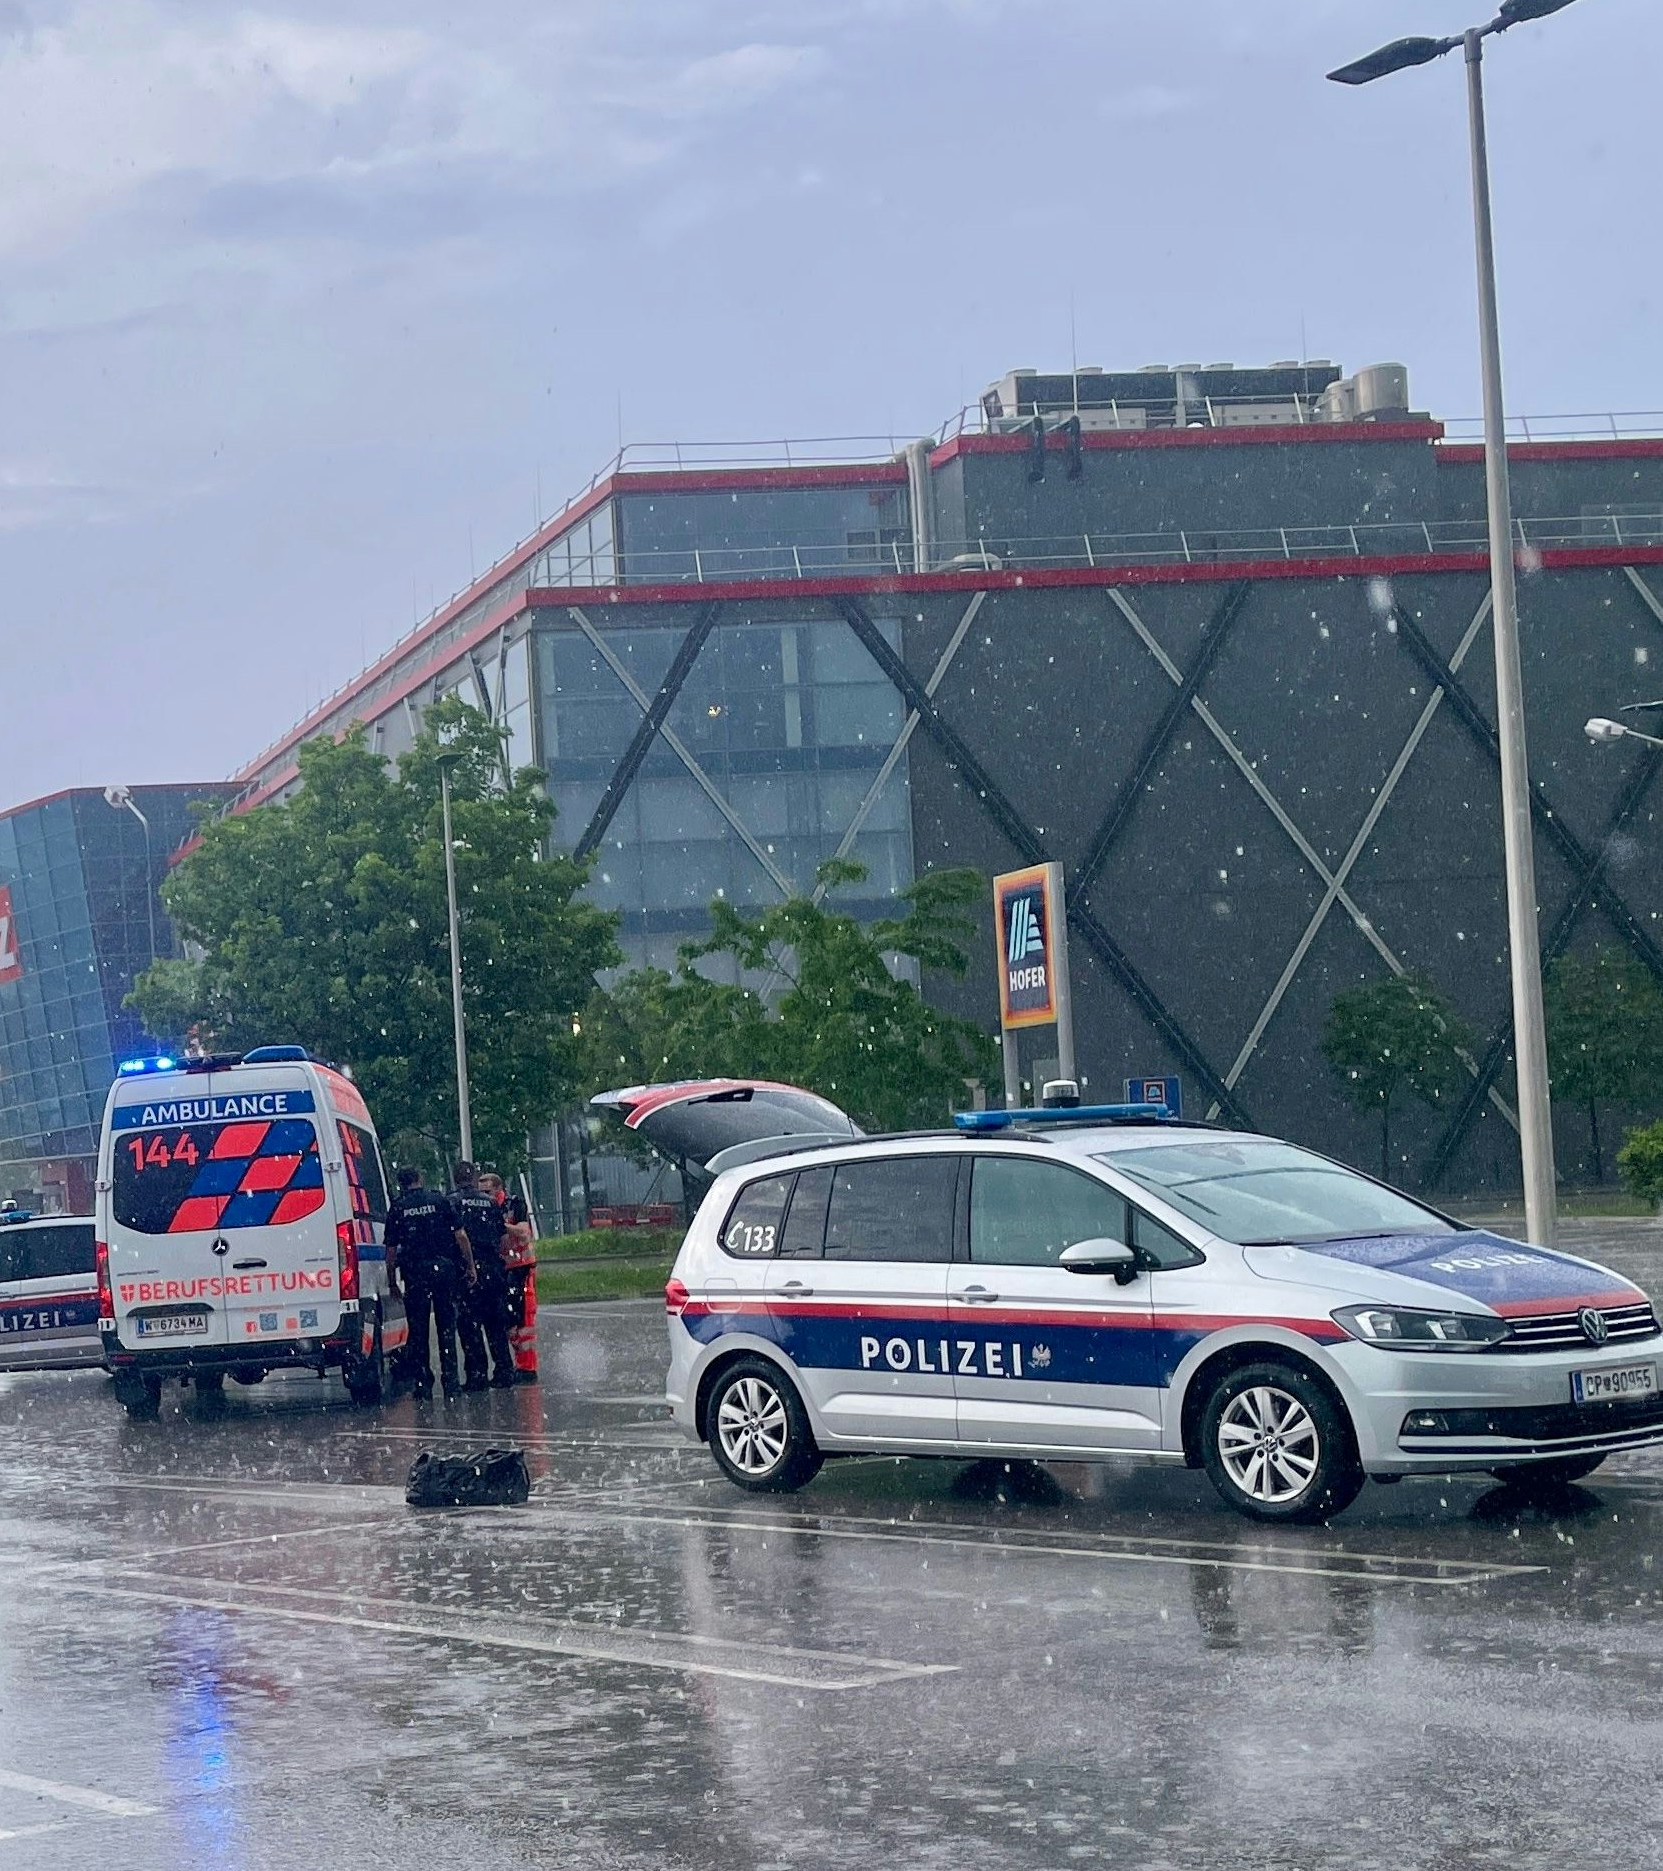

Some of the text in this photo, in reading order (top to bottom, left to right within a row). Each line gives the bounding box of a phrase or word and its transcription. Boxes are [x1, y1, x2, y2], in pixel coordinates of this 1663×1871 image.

[1009, 965, 1046, 992] HOFER
[141, 1094, 287, 1125] AMBULANCE
[128, 1132, 200, 1171] 144
[744, 1225, 776, 1252] 133
[1429, 1253, 1554, 1273] POLIZE
[139, 1269, 333, 1301] BERUFSRETTUNG
[861, 1336, 1023, 1377] POLIZEI
